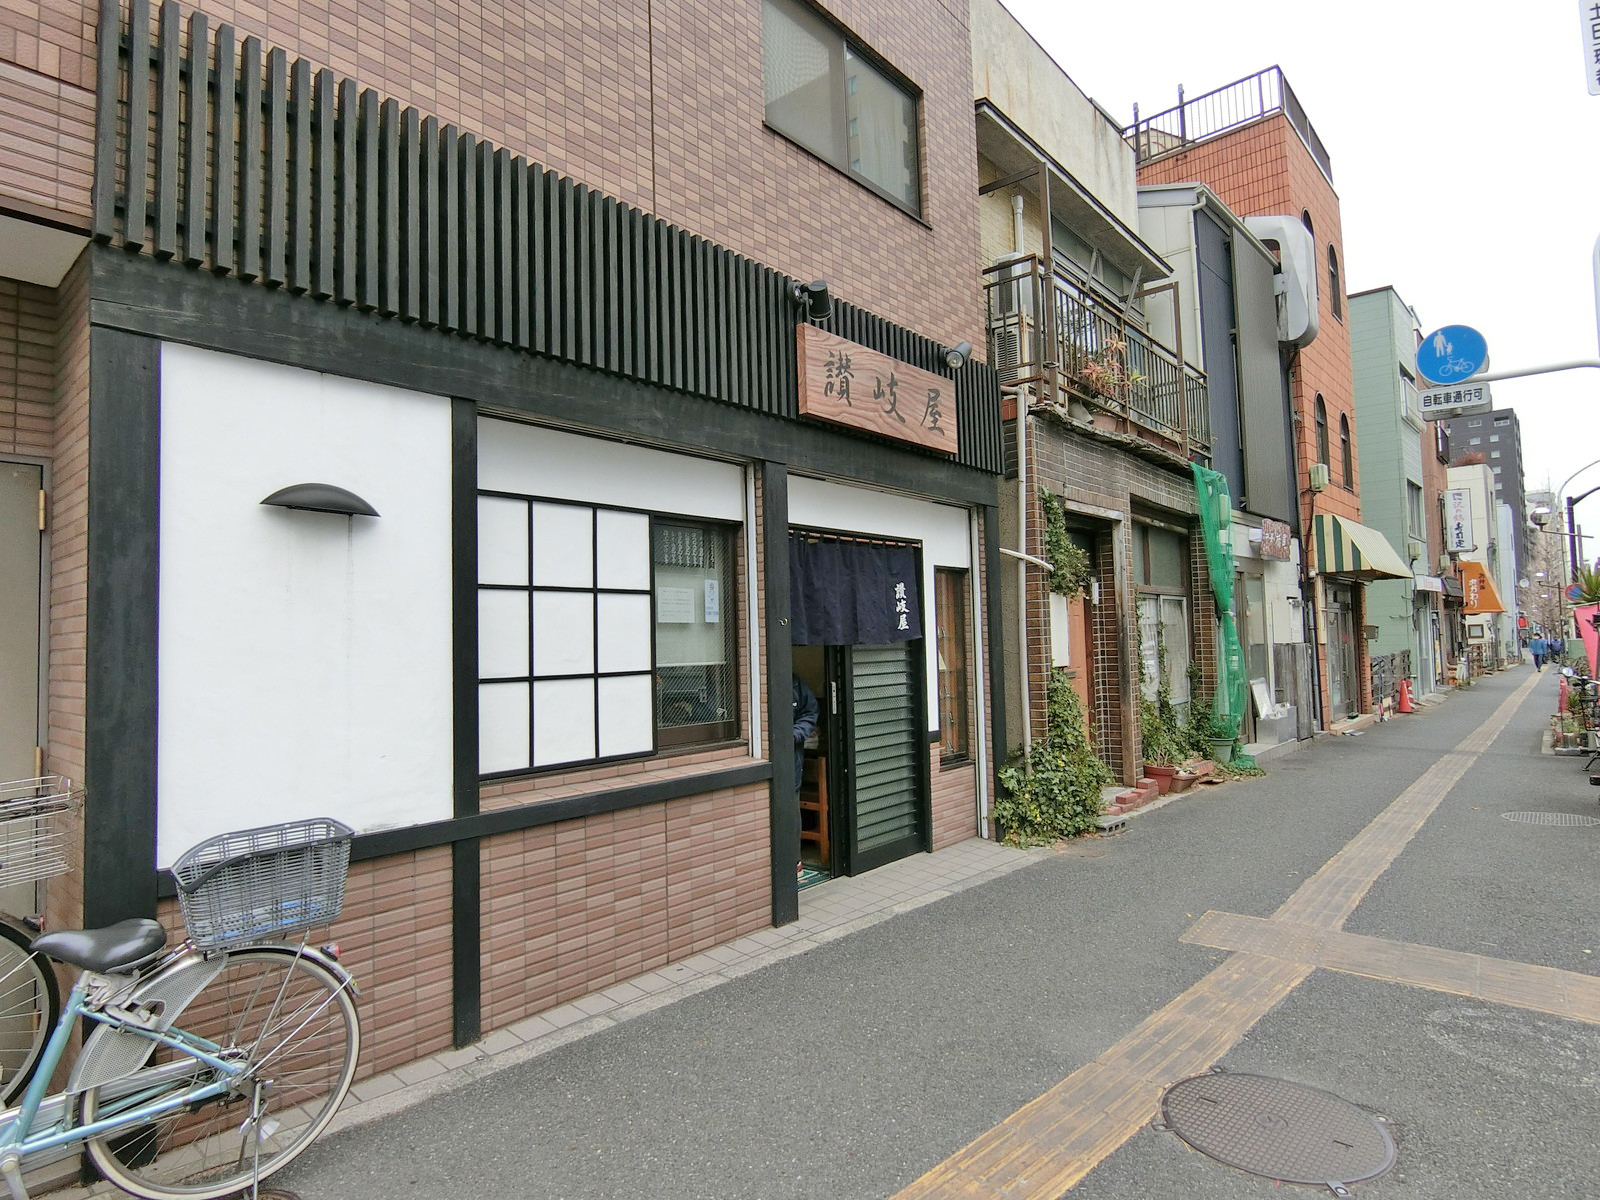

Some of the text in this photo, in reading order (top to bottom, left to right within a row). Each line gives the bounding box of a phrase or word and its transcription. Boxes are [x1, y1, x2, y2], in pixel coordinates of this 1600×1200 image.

[1423, 388, 1483, 407] 自転車通行可
